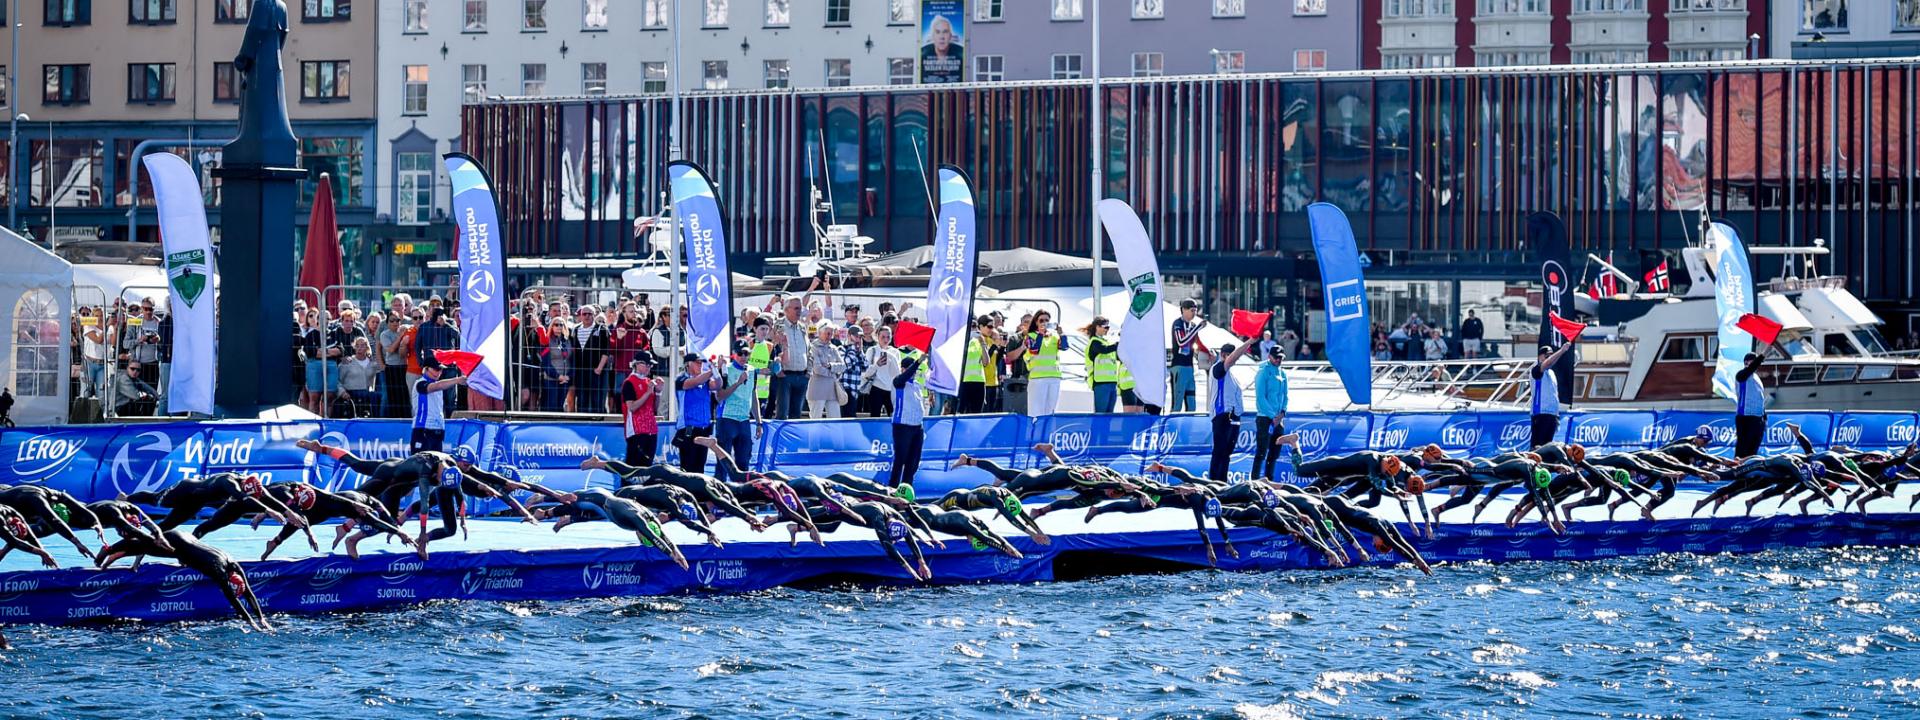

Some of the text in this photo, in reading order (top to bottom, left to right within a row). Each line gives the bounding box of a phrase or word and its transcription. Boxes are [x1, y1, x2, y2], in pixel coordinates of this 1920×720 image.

[1334, 294, 1362, 307] GRIEG
[1370, 429, 1408, 449] LERØY
[1443, 428, 1480, 446] LERØY
[1501, 424, 1531, 441] LERØ
[1574, 424, 1608, 443] LERØY
[1642, 424, 1677, 443] LERØY
[1832, 425, 1862, 444] LERØY
[871, 439, 888, 455] Be
[1132, 431, 1175, 451] LERØY
[16, 439, 82, 462] LERØY
[185, 438, 254, 464] World
[517, 443, 589, 457] World Triathlon
[891, 526, 900, 537] 53
[484, 577, 523, 590] Triathlon
[606, 573, 641, 585] Triathlon
[300, 593, 341, 605] SJØTROLL
[377, 588, 417, 598] SJØTROLL
[68, 606, 111, 619] SJØTROLL
[151, 600, 196, 613] SJØTROLL
